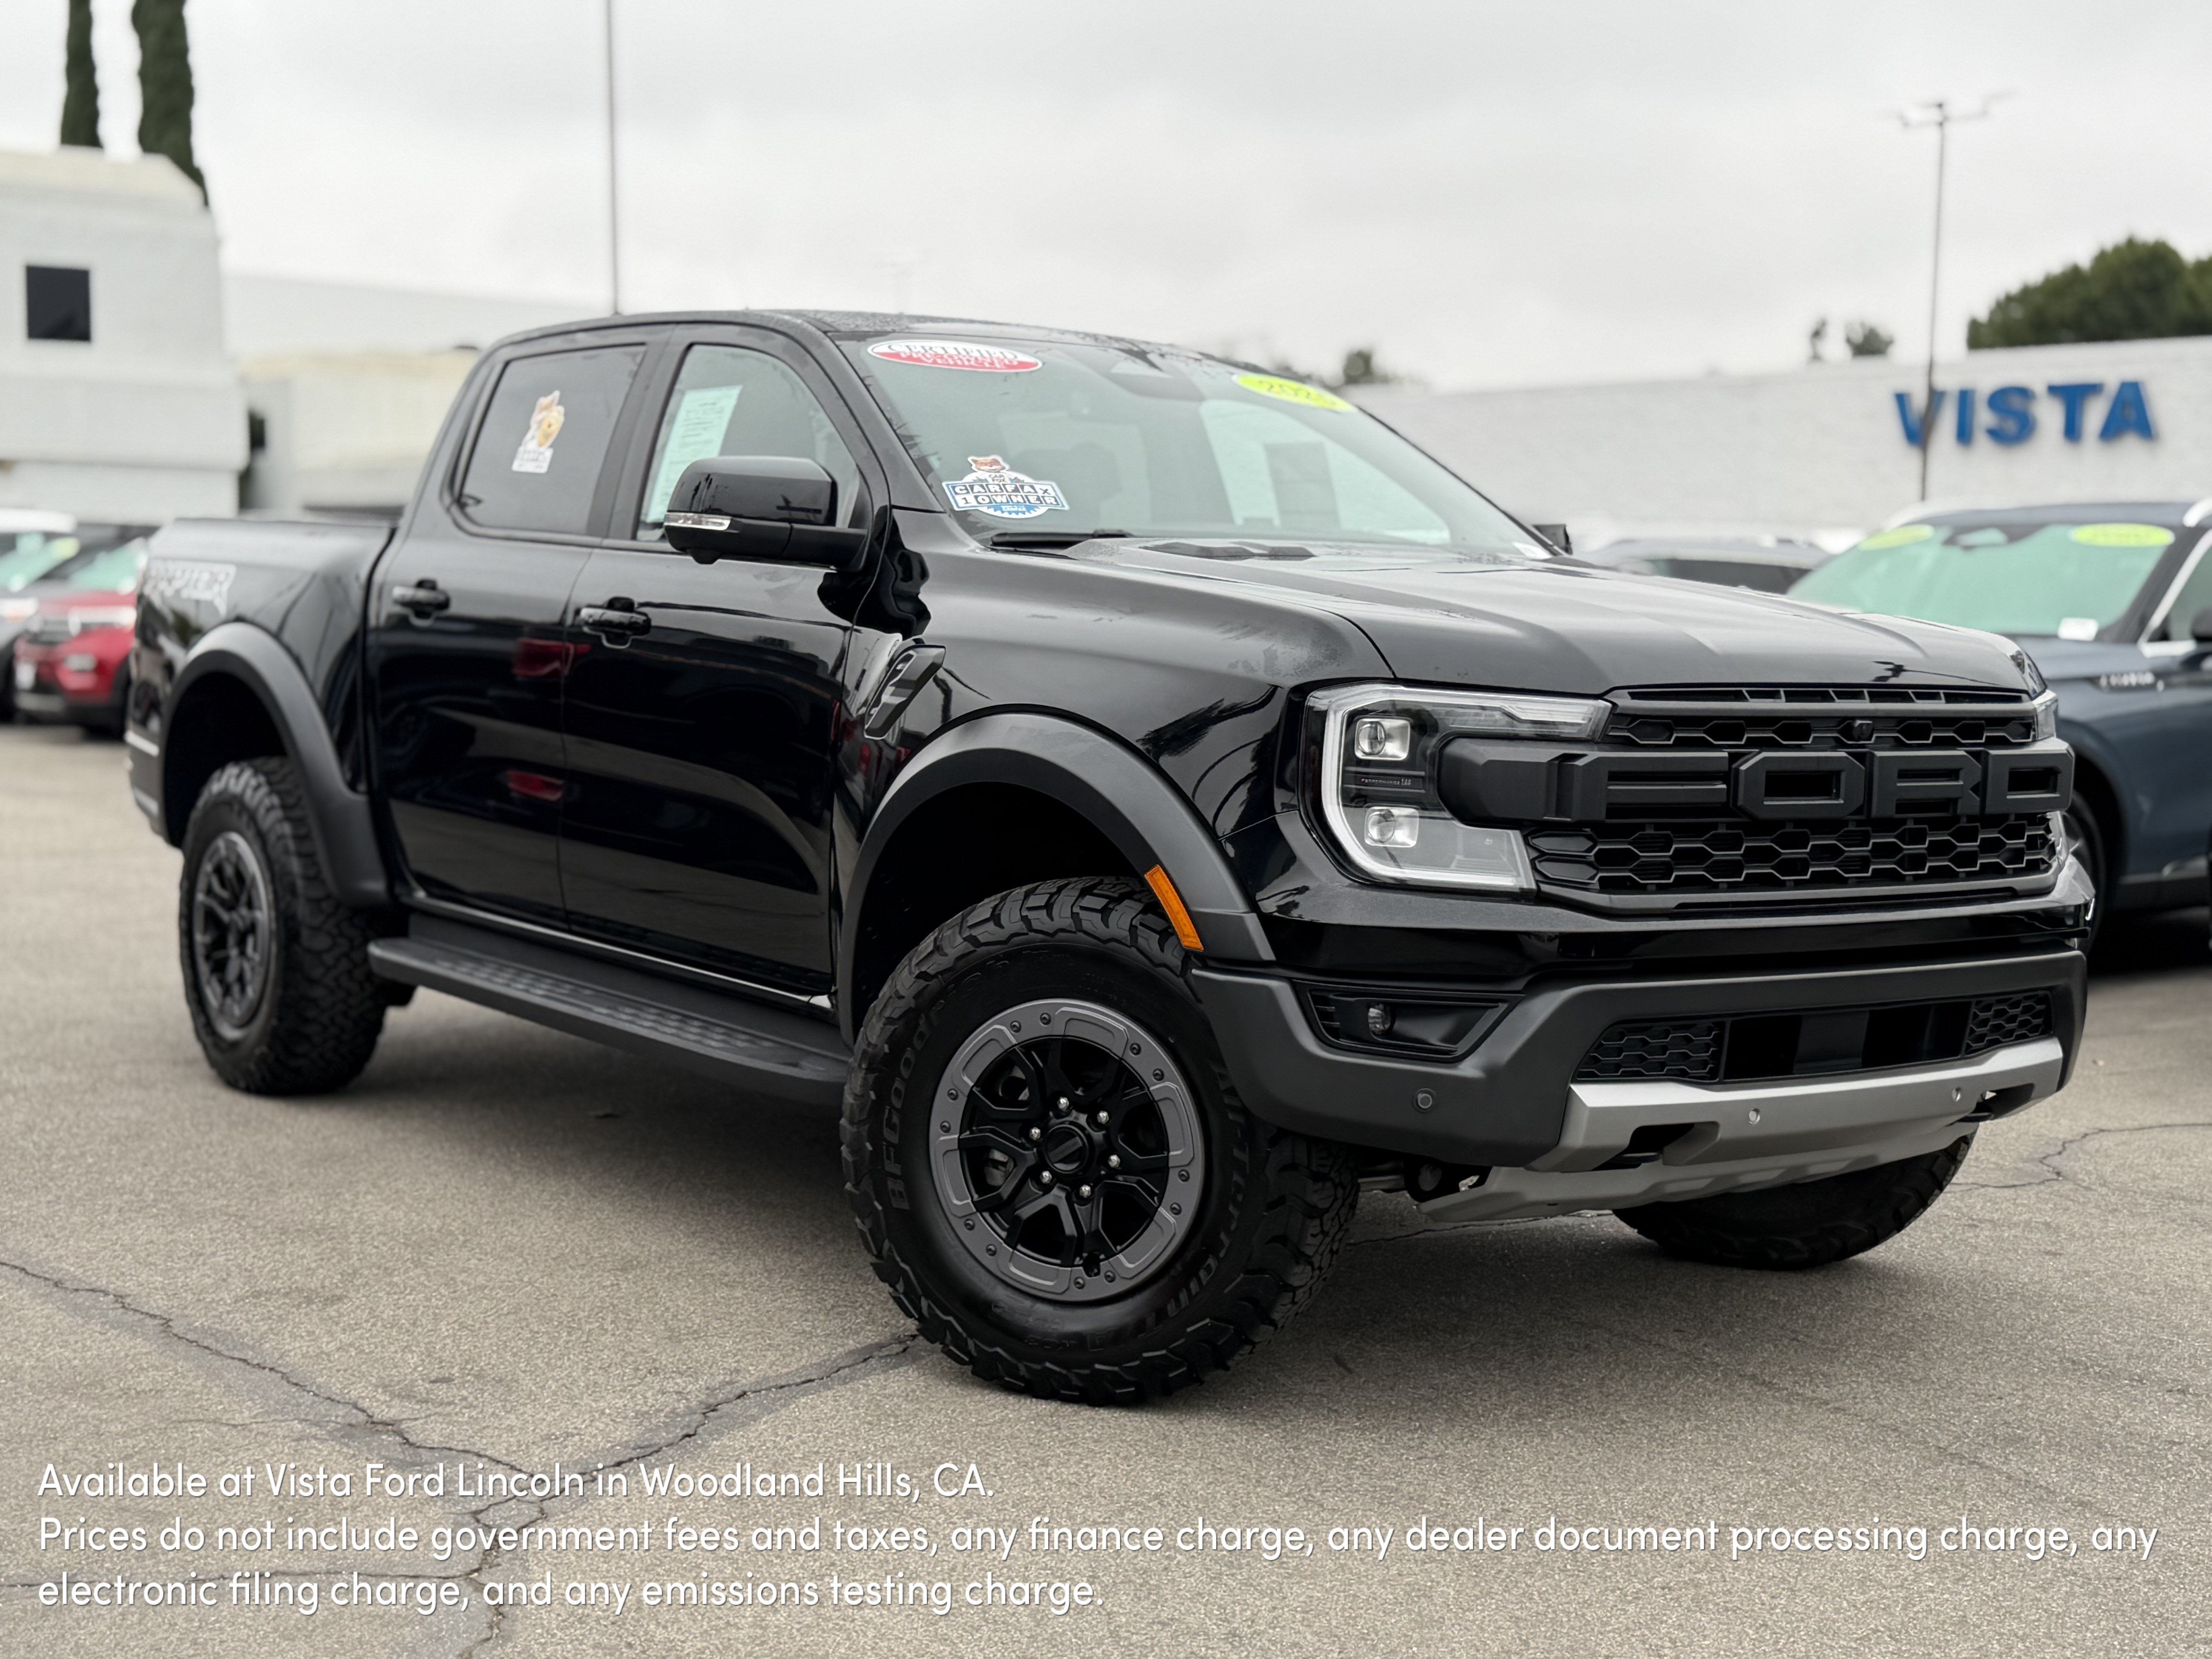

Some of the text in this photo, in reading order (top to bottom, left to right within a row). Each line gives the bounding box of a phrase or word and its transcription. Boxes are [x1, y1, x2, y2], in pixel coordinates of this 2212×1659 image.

[887, 343, 1018, 359] CERTIFIED
[1894, 381, 2157, 446] VISTA
[954, 485, 1051, 495] CARFAX
[977, 495, 1057, 505] OWNER
[1570, 749, 2075, 820] FORD
